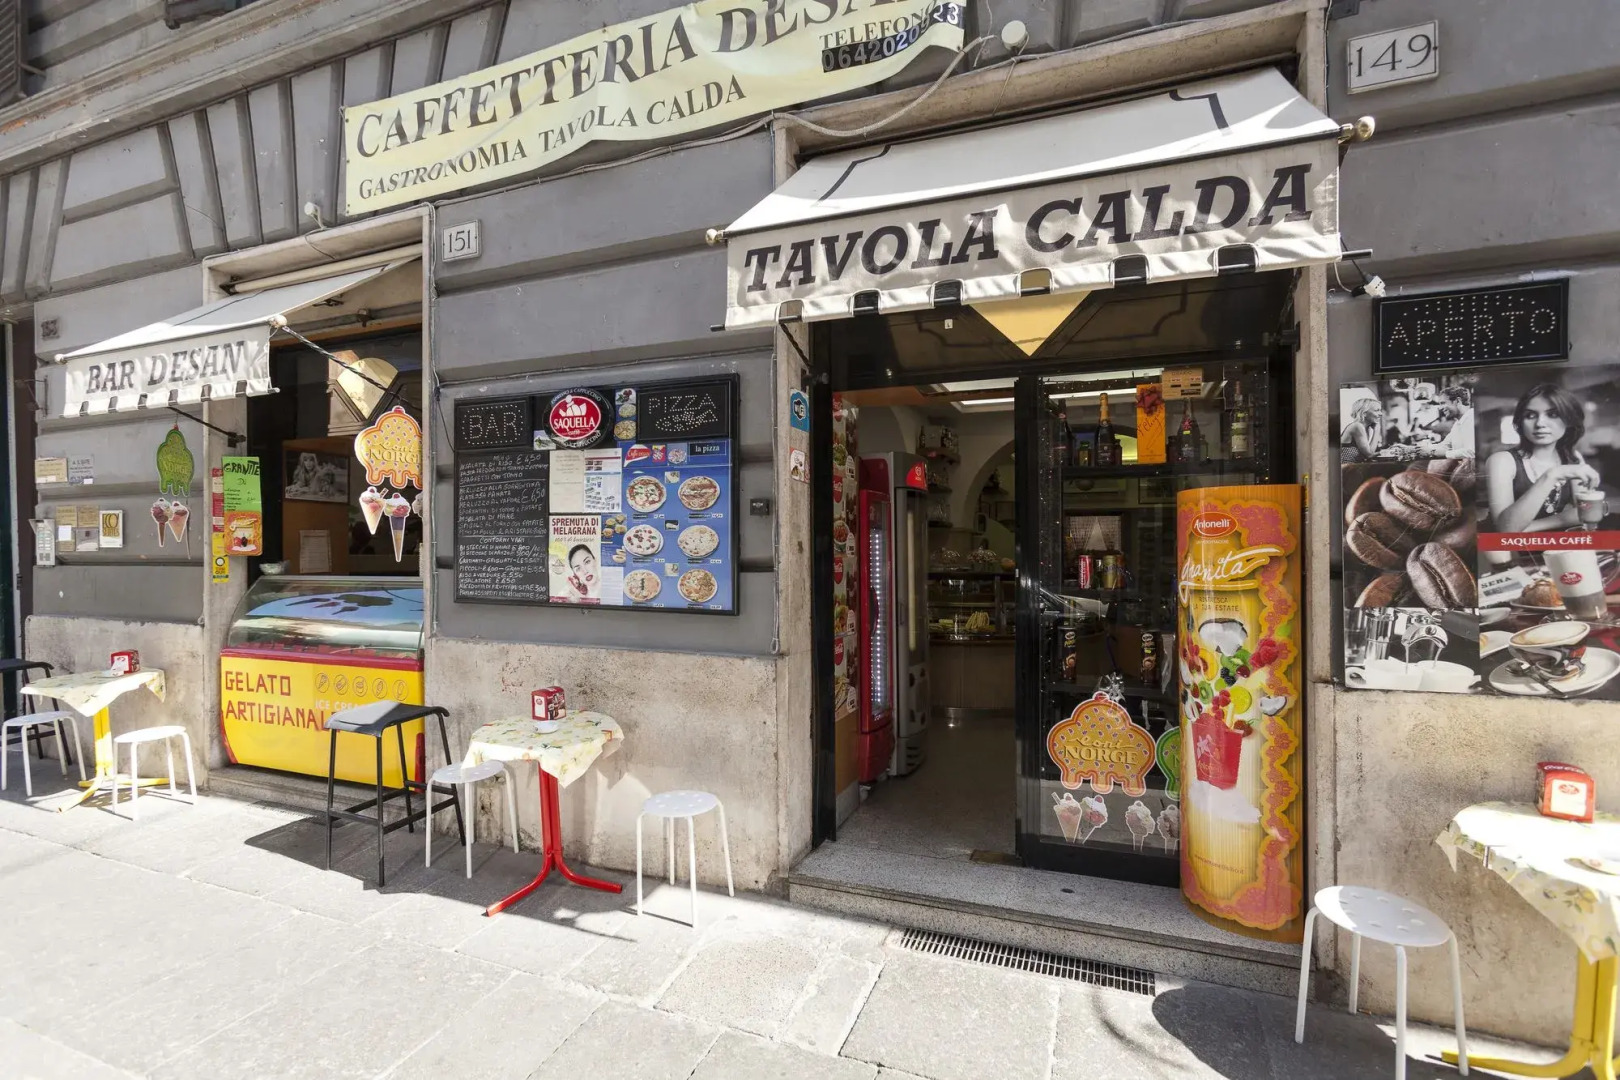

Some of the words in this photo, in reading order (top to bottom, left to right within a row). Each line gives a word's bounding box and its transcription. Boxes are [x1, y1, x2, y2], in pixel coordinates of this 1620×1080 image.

[1356, 34, 1432, 77] 149
[356, 13, 697, 158] CAFFETTERIA
[359, 138, 527, 199] GASTRONOMIA
[538, 104, 638, 153] TAVOLA
[645, 75, 746, 126] CALDA
[745, 208, 1000, 292] TAVOLA
[1024, 162, 1312, 251] CALDA
[449, 229, 471, 253] 151
[1388, 309, 1555, 347] APERTO
[86, 359, 135, 394] BAR
[649, 393, 716, 414] PIZZA
[470, 411, 517, 439] BAR
[553, 417, 595, 431] SAQUELLA
[703, 445, 720, 453] pizza
[223, 460, 260, 476] GRANITE
[552, 518, 589, 526] SPREMUTA
[591, 518, 599, 526] DI
[553, 527, 597, 535] MELAGRANA
[1194, 518, 1231, 530] Antonelli
[1500, 537, 1556, 546] SAQUELLA
[1559, 534, 1593, 545] CAFFÈ
[225, 670, 291, 696] GELATO
[226, 700, 340, 733] ARTIGIANAL
[315, 700, 331, 711] ICE
[1064, 745, 1138, 765] NORGE
